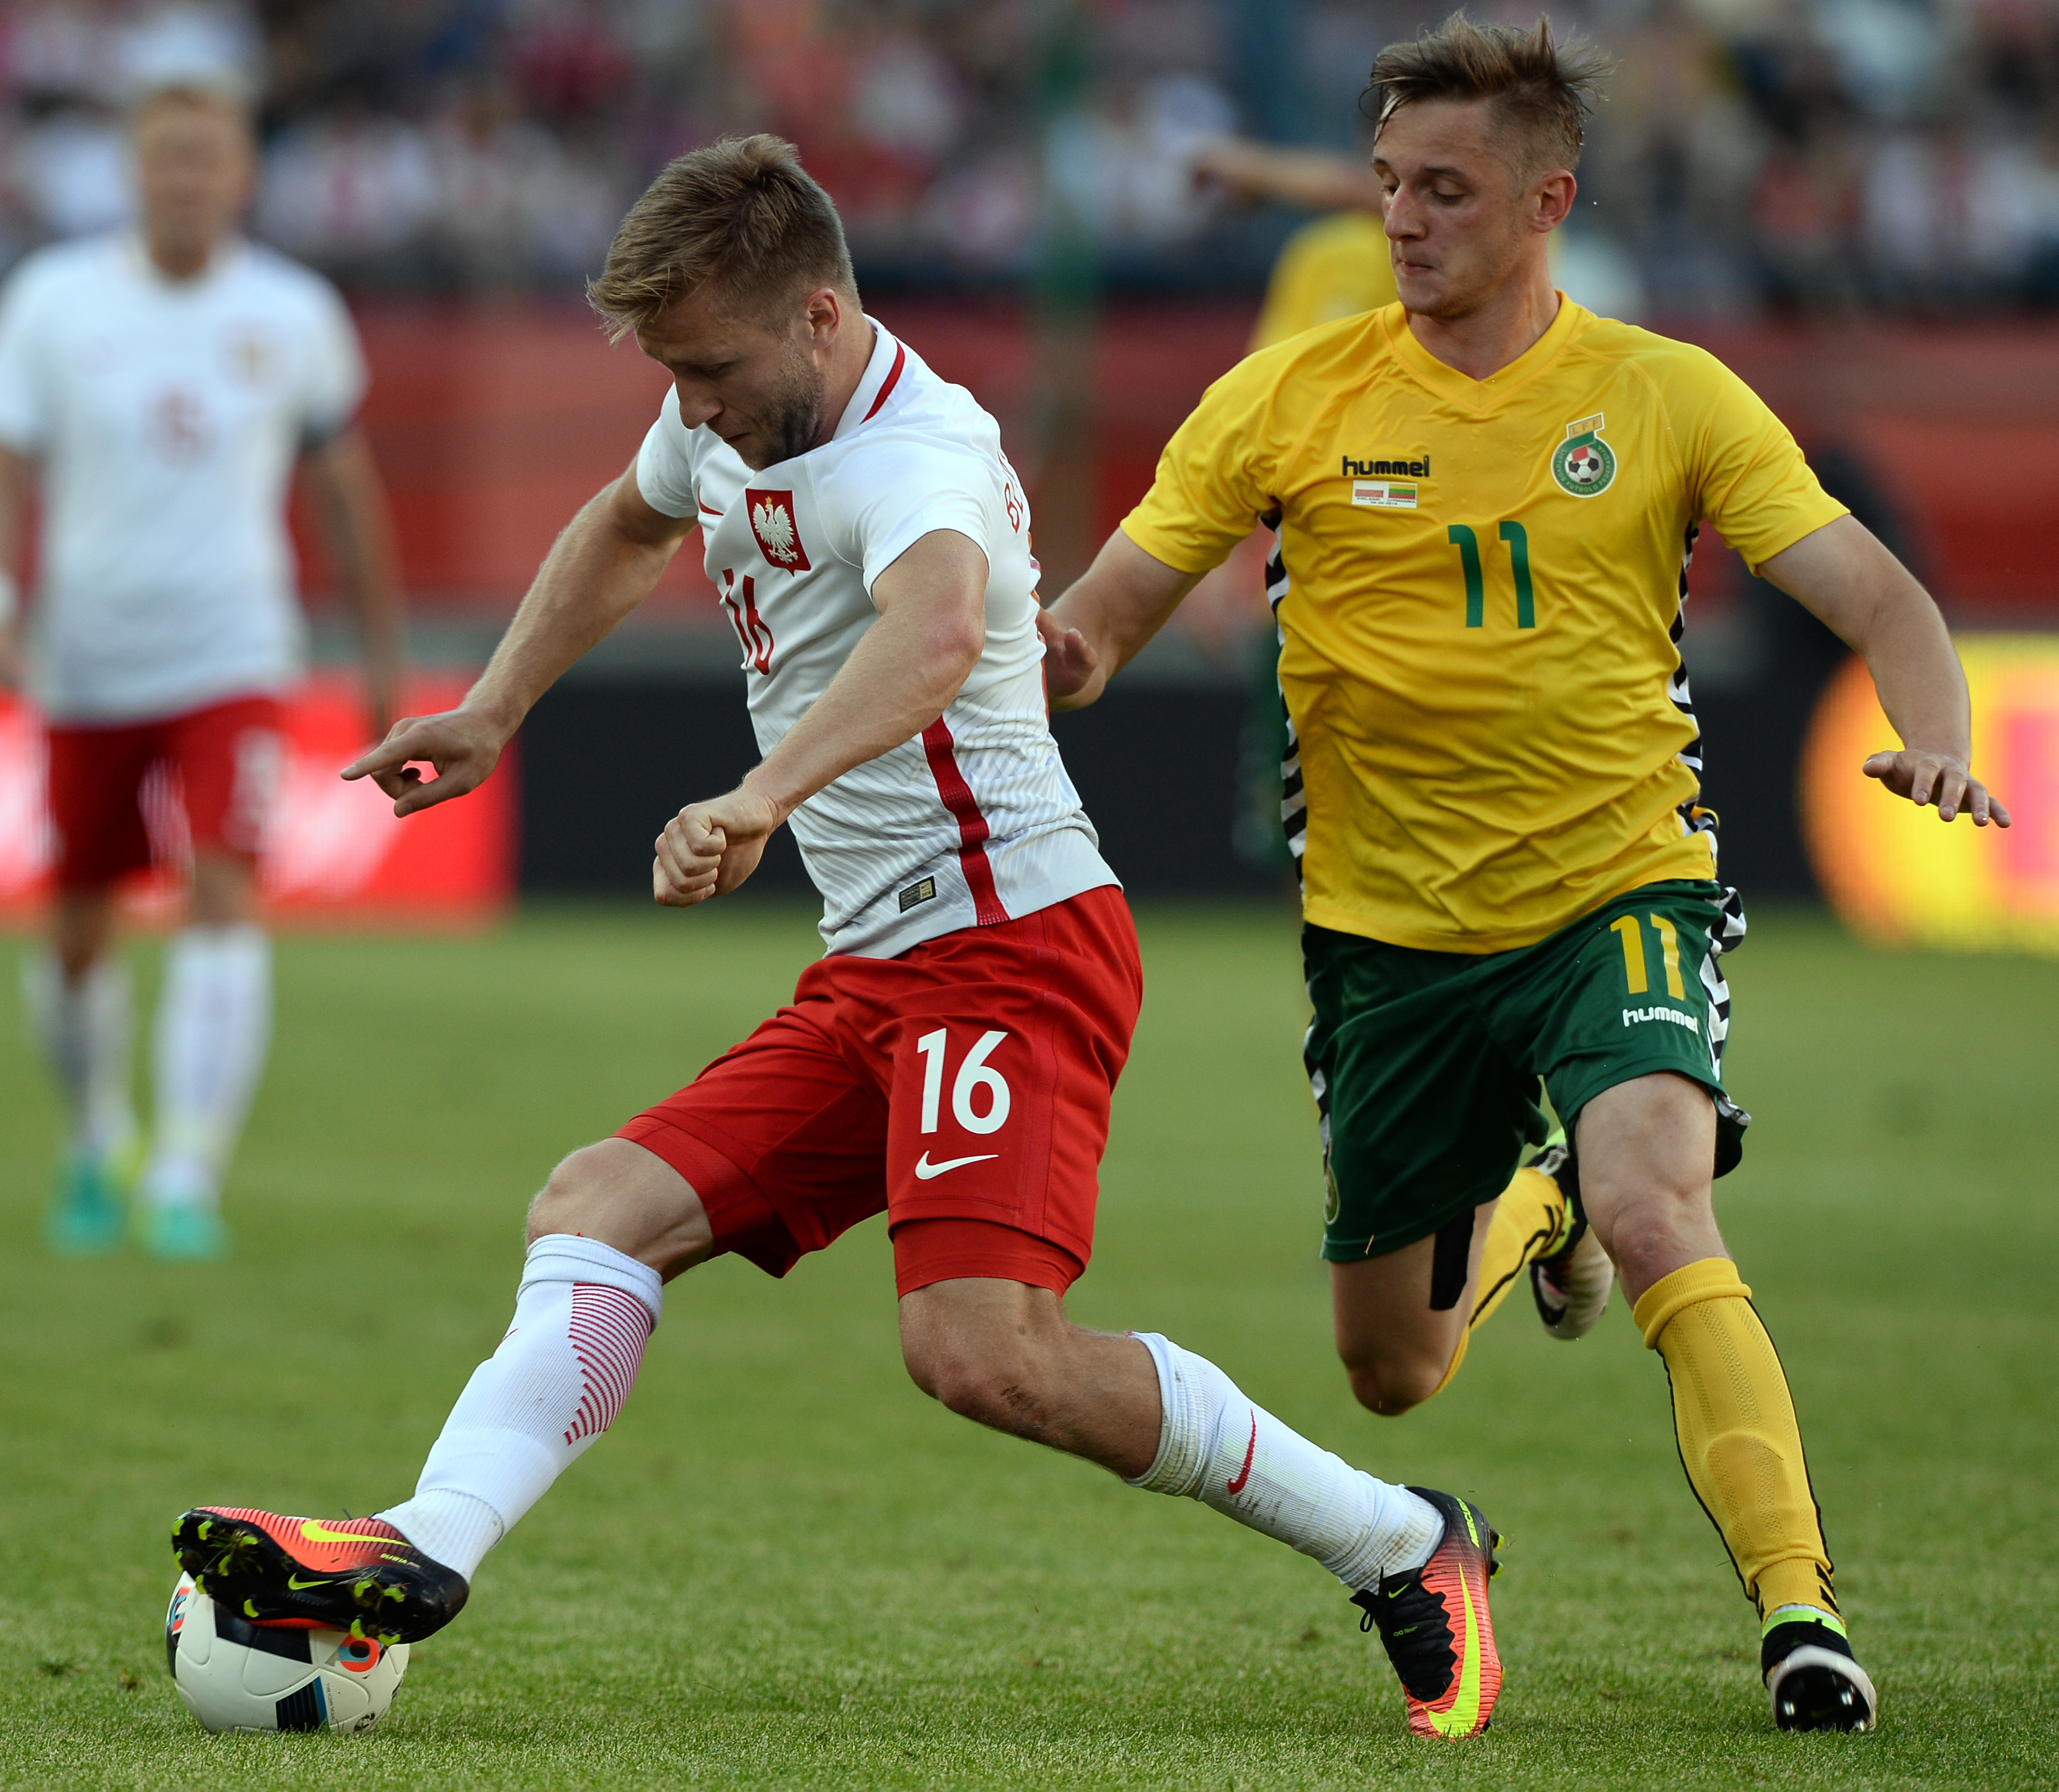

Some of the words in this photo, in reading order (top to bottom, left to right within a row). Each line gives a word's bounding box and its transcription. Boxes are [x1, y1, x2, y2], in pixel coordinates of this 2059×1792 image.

[1572, 419, 1599, 434] LFF
[1342, 455, 1430, 477] hummel
[1566, 481, 1598, 493] FUTBOLO
[1447, 520, 1535, 628] 11
[722, 568, 774, 675] 16
[1610, 913, 1685, 1001] 11
[1622, 1006, 1699, 1034] hummel
[917, 1027, 1011, 1135] 16
